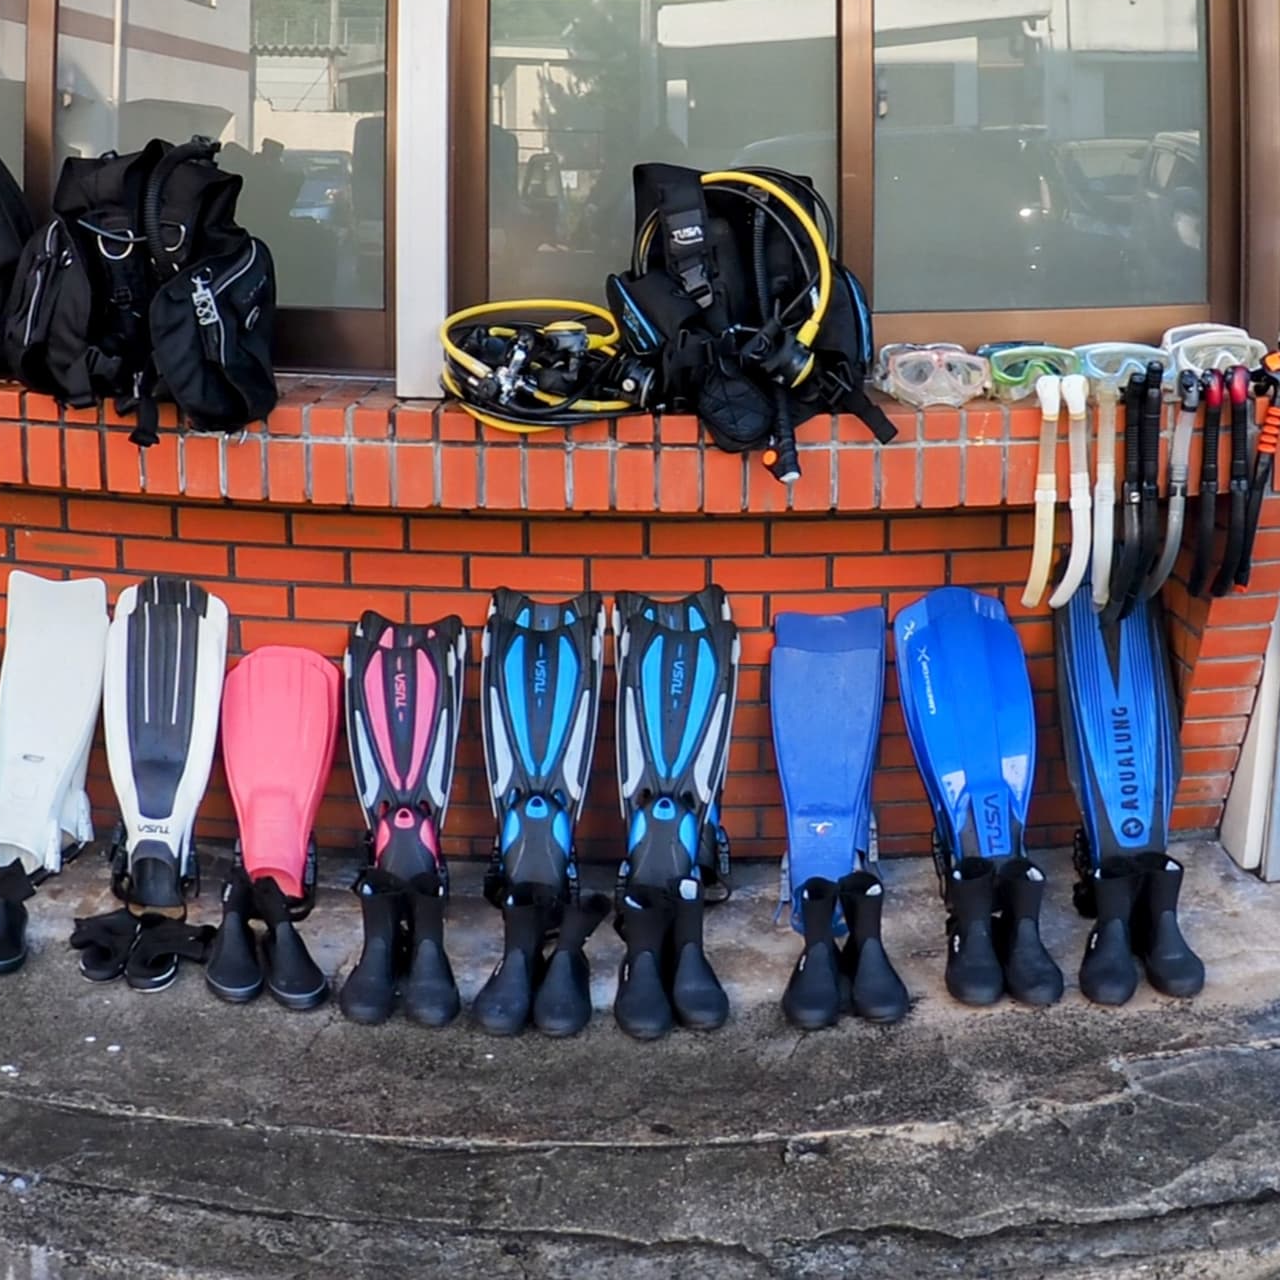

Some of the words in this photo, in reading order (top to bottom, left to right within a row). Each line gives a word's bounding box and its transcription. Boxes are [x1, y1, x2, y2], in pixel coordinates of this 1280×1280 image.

[671, 225, 703, 241] TUSA
[394, 673, 407, 710] TUSA
[534, 660, 547, 695] TUSA
[670, 660, 685, 696] TUSA
[1111, 706, 1139, 810] AQUALUNG
[137, 824, 170, 834] TUSA
[983, 793, 1005, 853] TUSA
